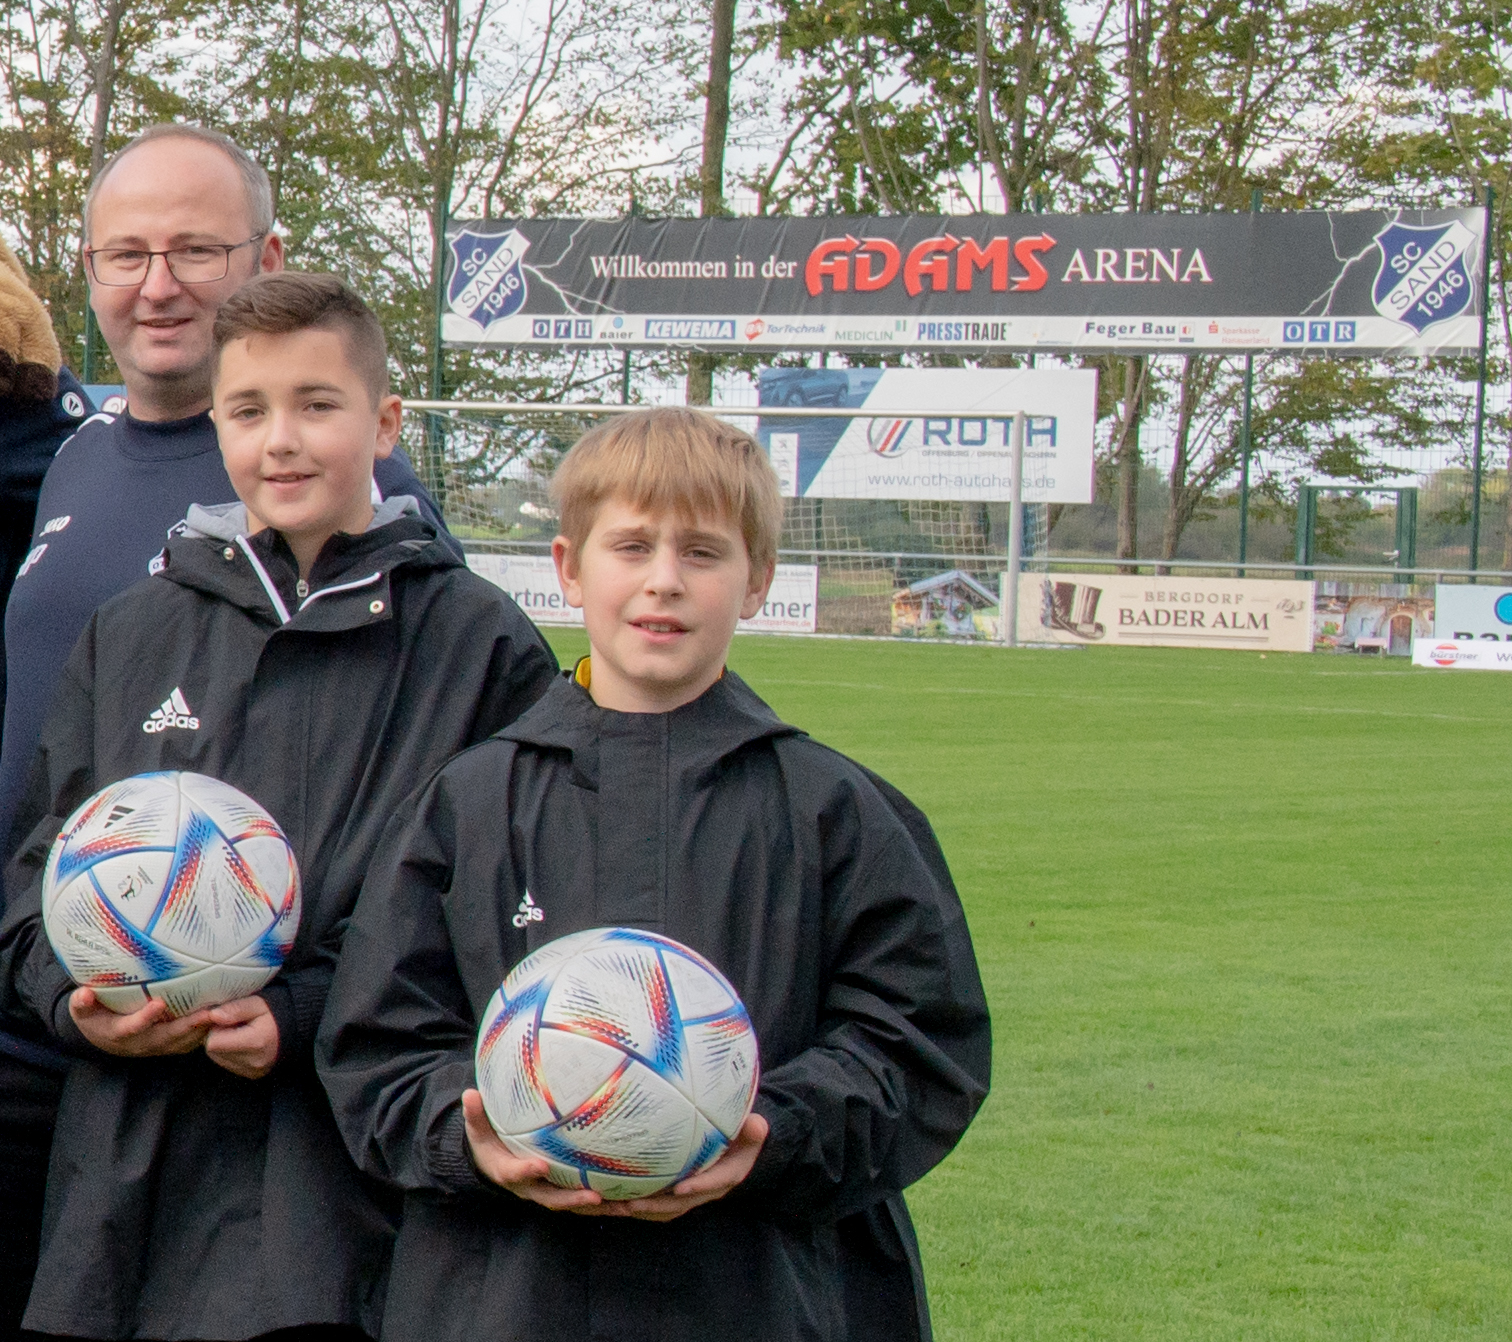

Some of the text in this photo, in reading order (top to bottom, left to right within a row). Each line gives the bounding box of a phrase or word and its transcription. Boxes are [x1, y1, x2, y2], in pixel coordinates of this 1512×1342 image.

[461, 247, 488, 277] SC
[590, 232, 1213, 297] Willkommen in der ADAMS ARENA
[1390, 242, 1422, 275] SC
[461, 247, 516, 309] SAND
[1390, 241, 1455, 310] SAND
[483, 275, 520, 316] 1946
[1417, 269, 1464, 318] 1946
[646, 320, 733, 339] KEWEMA
[835, 329, 893, 341] MEDICLIN
[1085, 322, 1176, 338] Feger Bau
[923, 417, 1057, 448] ROTH
[1144, 591, 1245, 605] BERGDORF
[1118, 608, 1269, 631] BADER ALM
